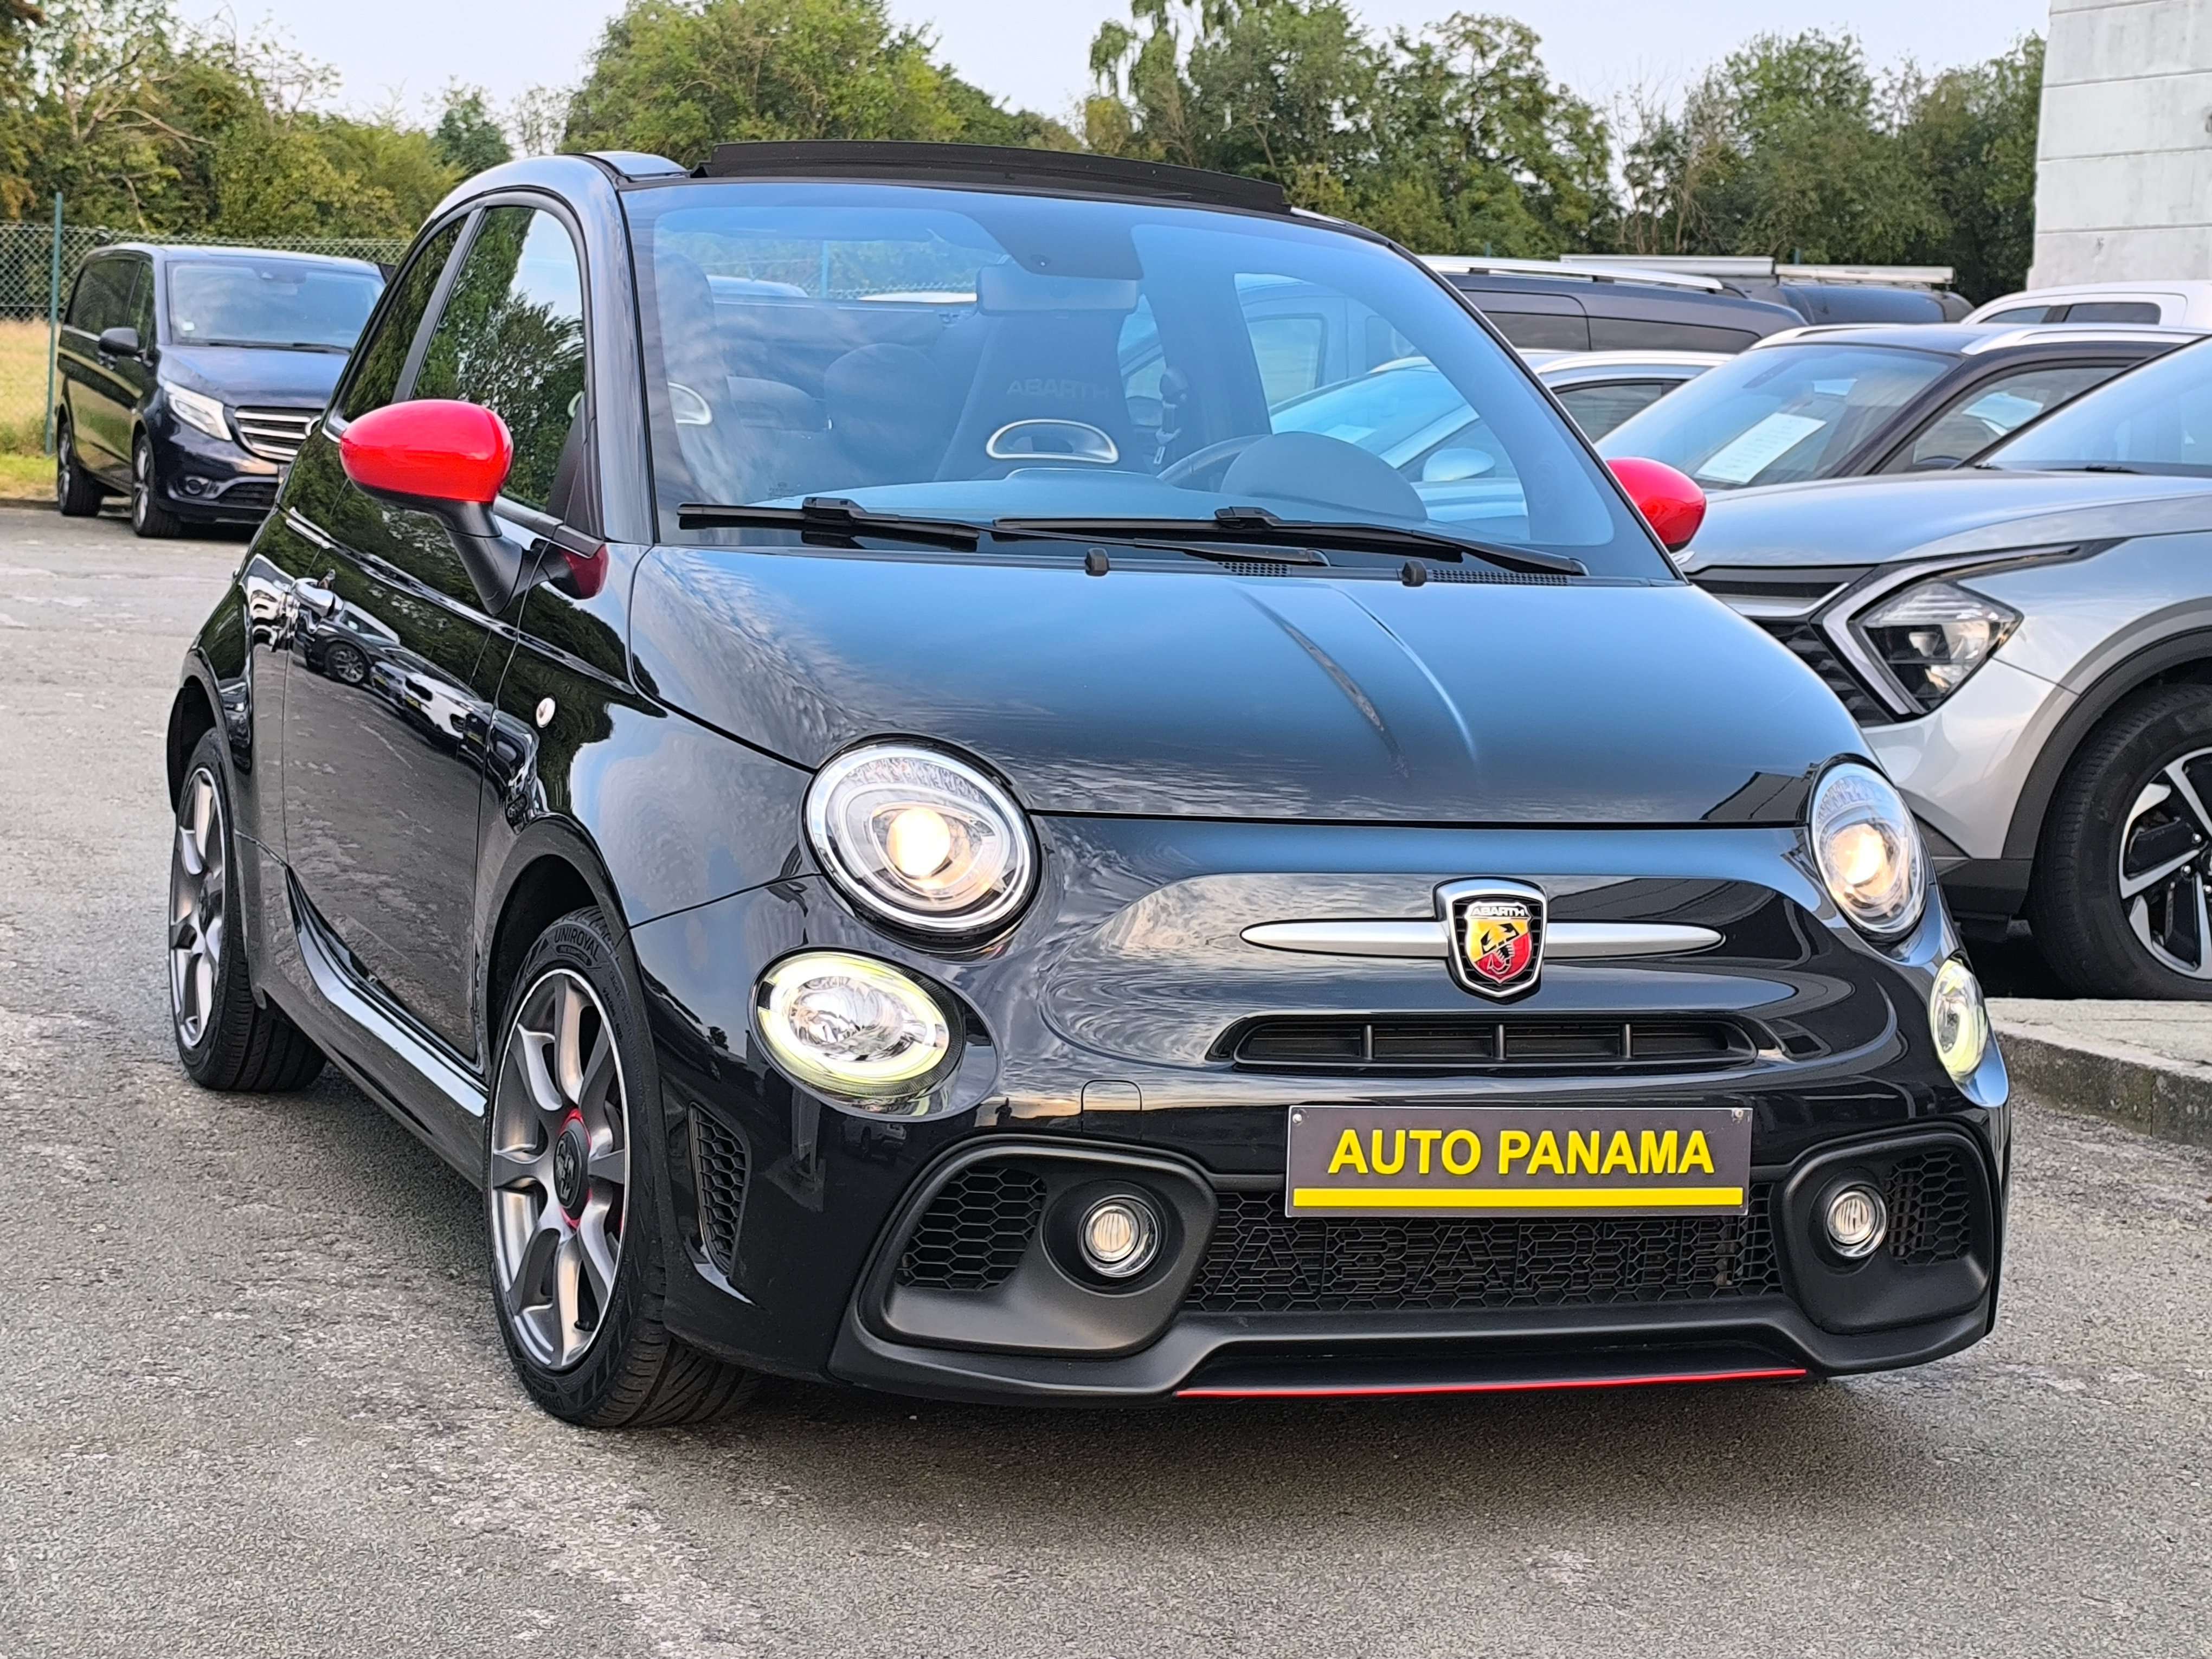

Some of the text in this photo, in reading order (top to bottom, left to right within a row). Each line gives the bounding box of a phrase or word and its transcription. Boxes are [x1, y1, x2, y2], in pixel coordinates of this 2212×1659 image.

[1006, 378, 1110, 399] ABARTH
[1471, 906, 1525, 916] ABARTH
[555, 927, 598, 962] UNIROYAL
[1327, 1129, 1715, 1175] AUTO PANAMA
